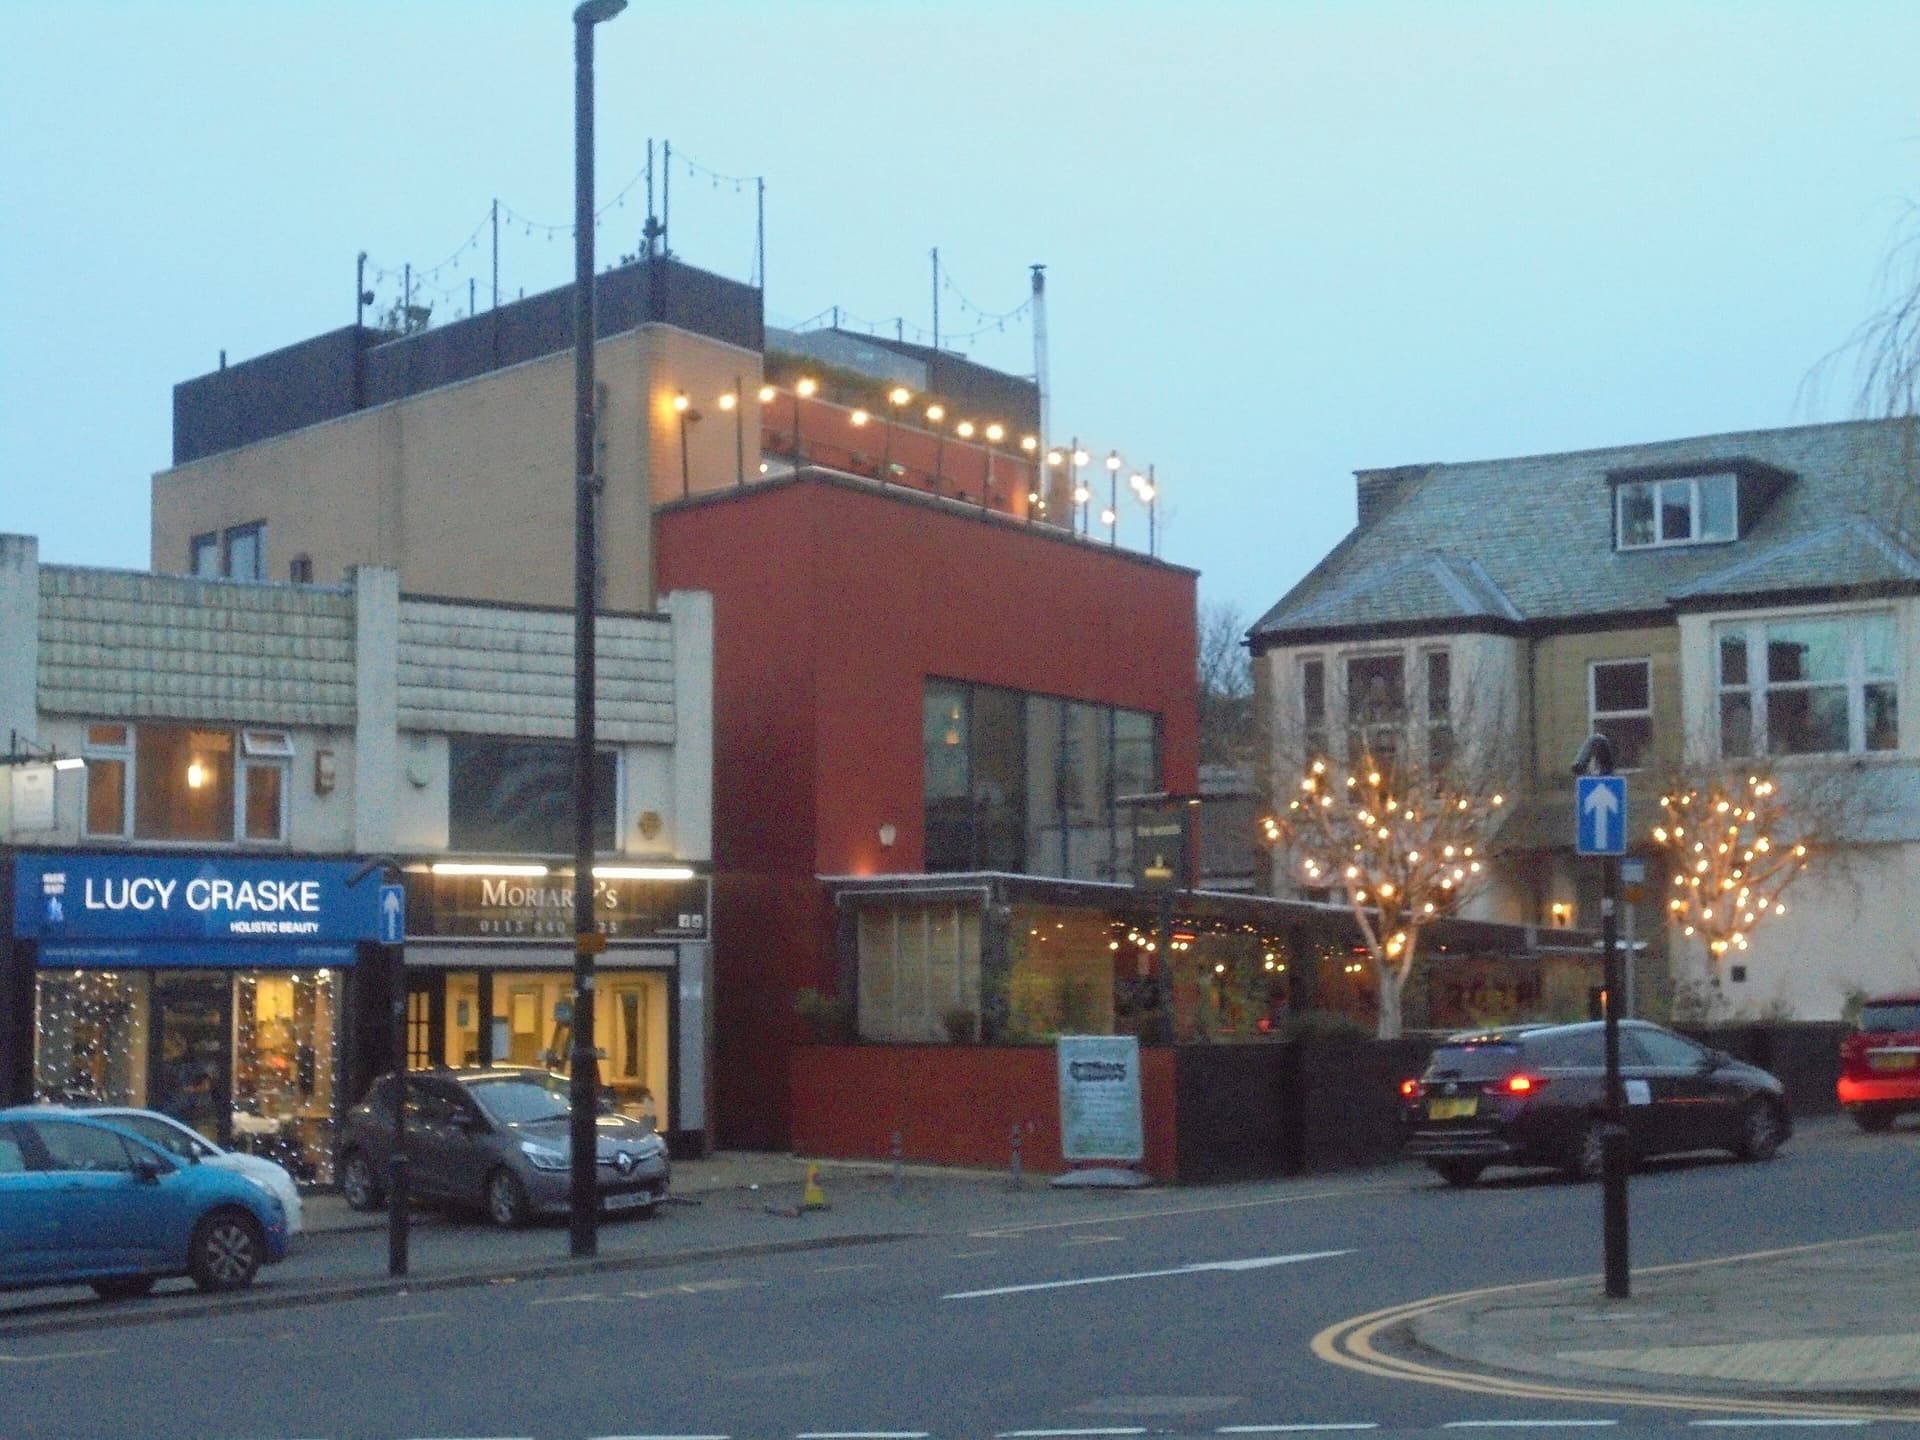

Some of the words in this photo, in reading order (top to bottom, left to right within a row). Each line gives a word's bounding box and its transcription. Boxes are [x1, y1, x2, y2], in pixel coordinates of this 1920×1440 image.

[85, 877, 176, 909] LUCY
[186, 879, 320, 912] CRASKE
[230, 920, 278, 933] HOLISTIC
[279, 921, 320, 933] BEAUTY
